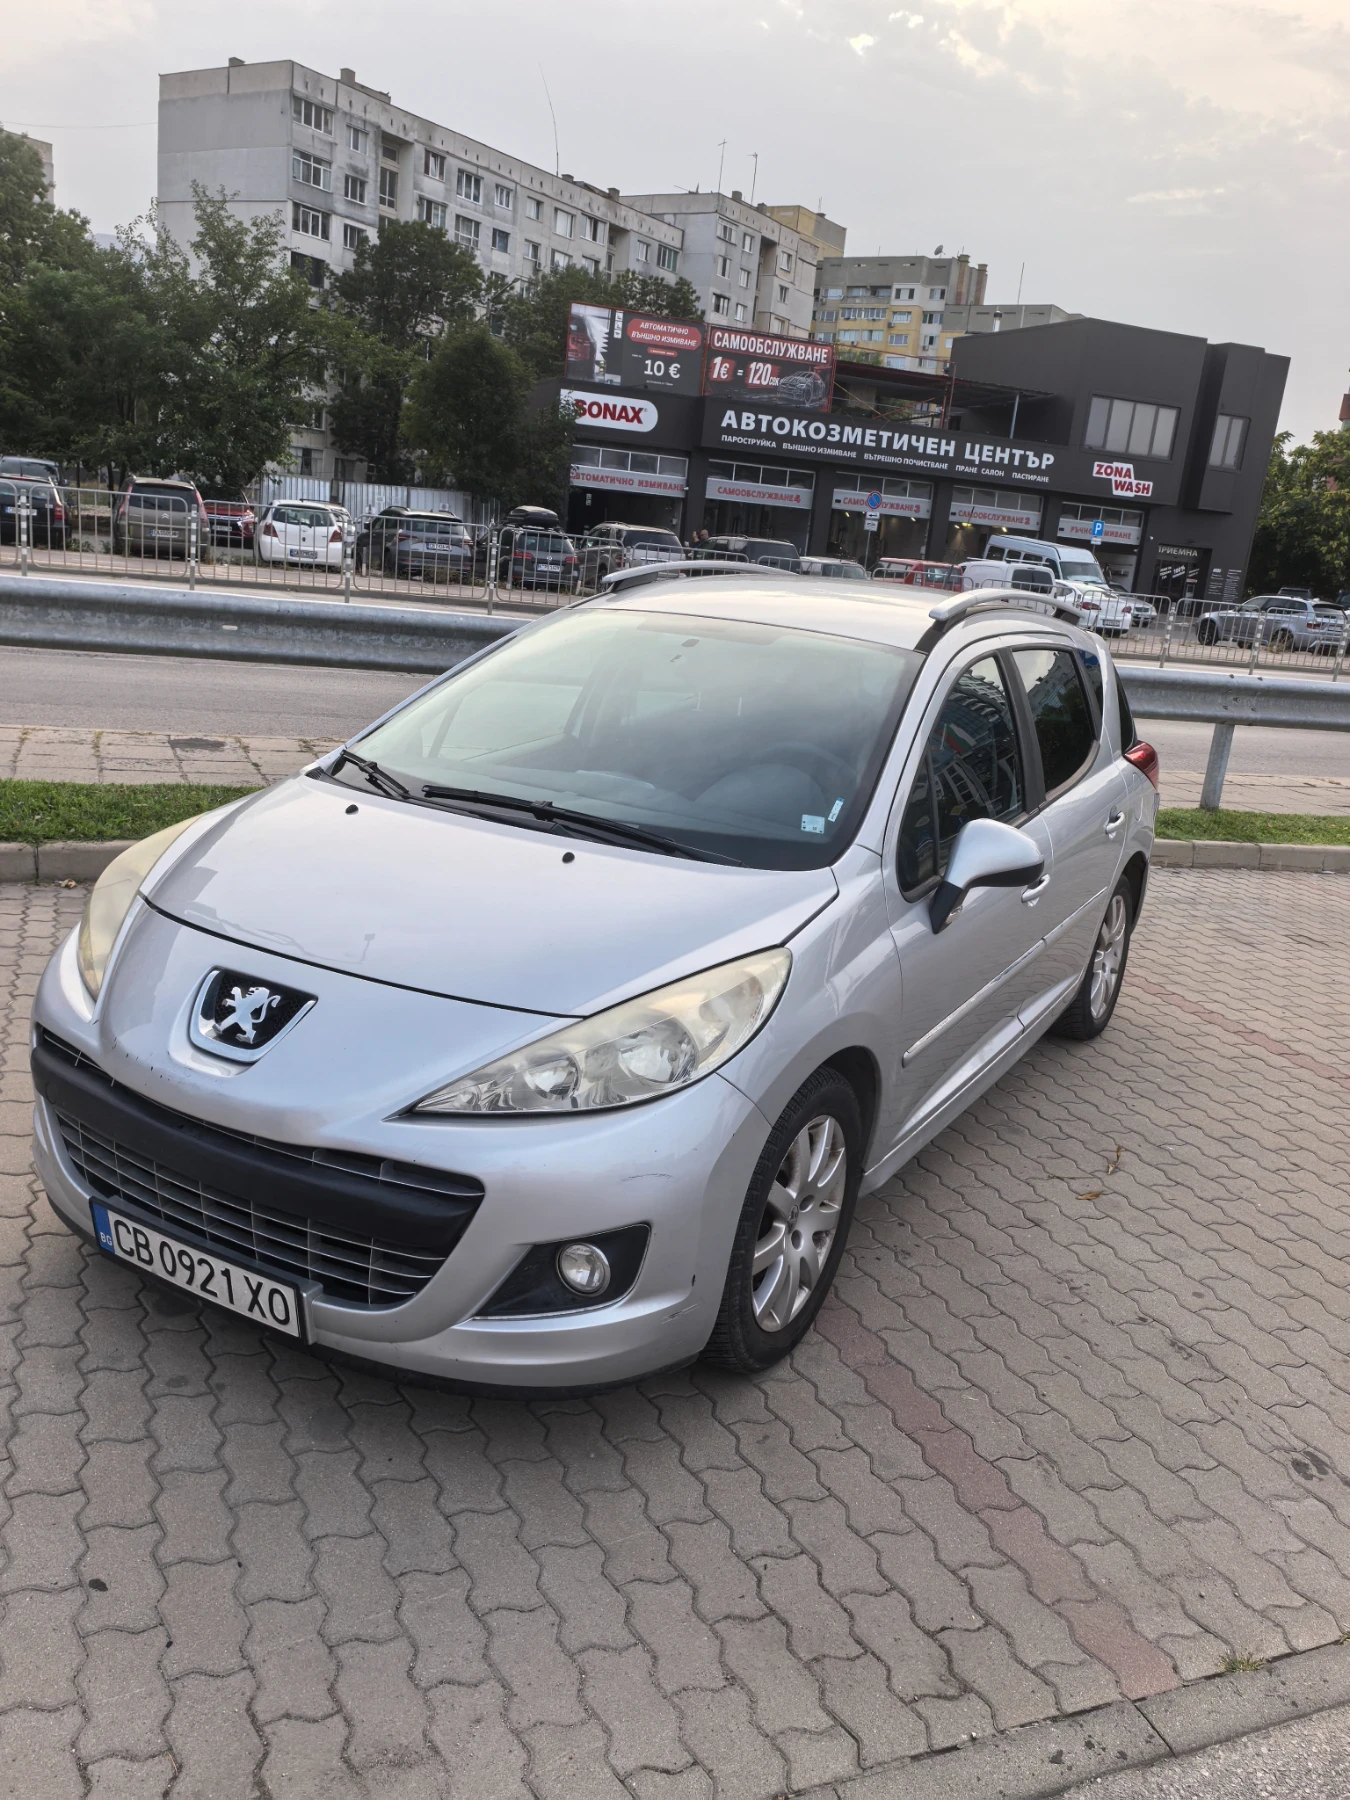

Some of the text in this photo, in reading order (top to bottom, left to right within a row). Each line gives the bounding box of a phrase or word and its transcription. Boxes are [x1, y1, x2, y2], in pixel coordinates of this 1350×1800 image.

[639, 322, 689, 335] АВТОМАТИЧНО
[631, 331, 698, 347] ВЪНШНО ИЗМИВАНЕ
[714, 331, 828, 363] САМООБСЛУЖВАНЕ
[644, 359, 681, 379] 10 €
[721, 410, 1055, 470] АВТОКОЗМЕТИЧЕН ЦЕНТЪР
[721, 434, 1049, 483] ПАРОСТРУЙКА ВЪНШНО ИЗМИВАНЕ ВЪТРЕШНО ПОЧИСТВАНЕ ПРАНЕ САЛОН ПАСТИРАНЕ
[1095, 463, 1132, 479] ZONA
[637, 479, 684, 491] ИЗМИВАНЕ
[1114, 479, 1151, 495] WASH
[717, 486, 793, 502] САМООБСЛУЖВАНЕ
[913, 504, 921, 513] 3
[958, 510, 1024, 524] САМООБСЛУЖВАНЕ
[1094, 522, 1103, 535] P
[100, 1232, 113, 1246] BG
